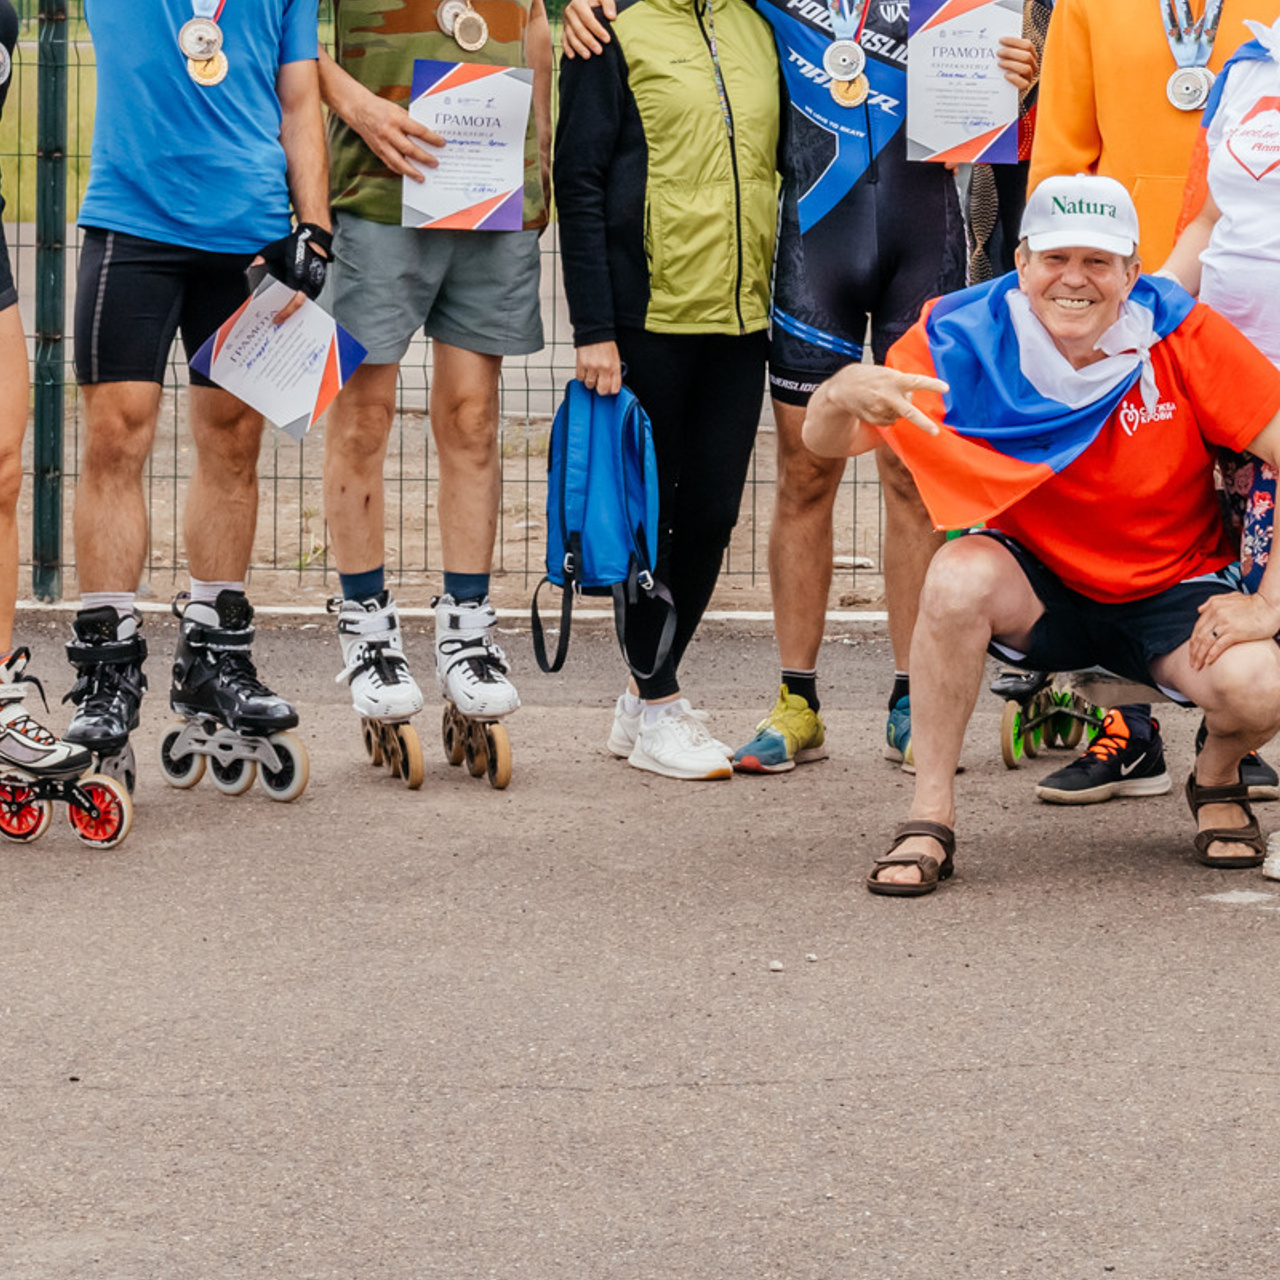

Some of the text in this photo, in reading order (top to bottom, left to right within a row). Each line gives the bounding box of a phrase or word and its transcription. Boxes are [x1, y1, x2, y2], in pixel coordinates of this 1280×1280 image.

[932, 46, 996, 59] ГРАМОТА
[434, 112, 502, 128] ГРАМОТА
[1050, 196, 1117, 219] Natura
